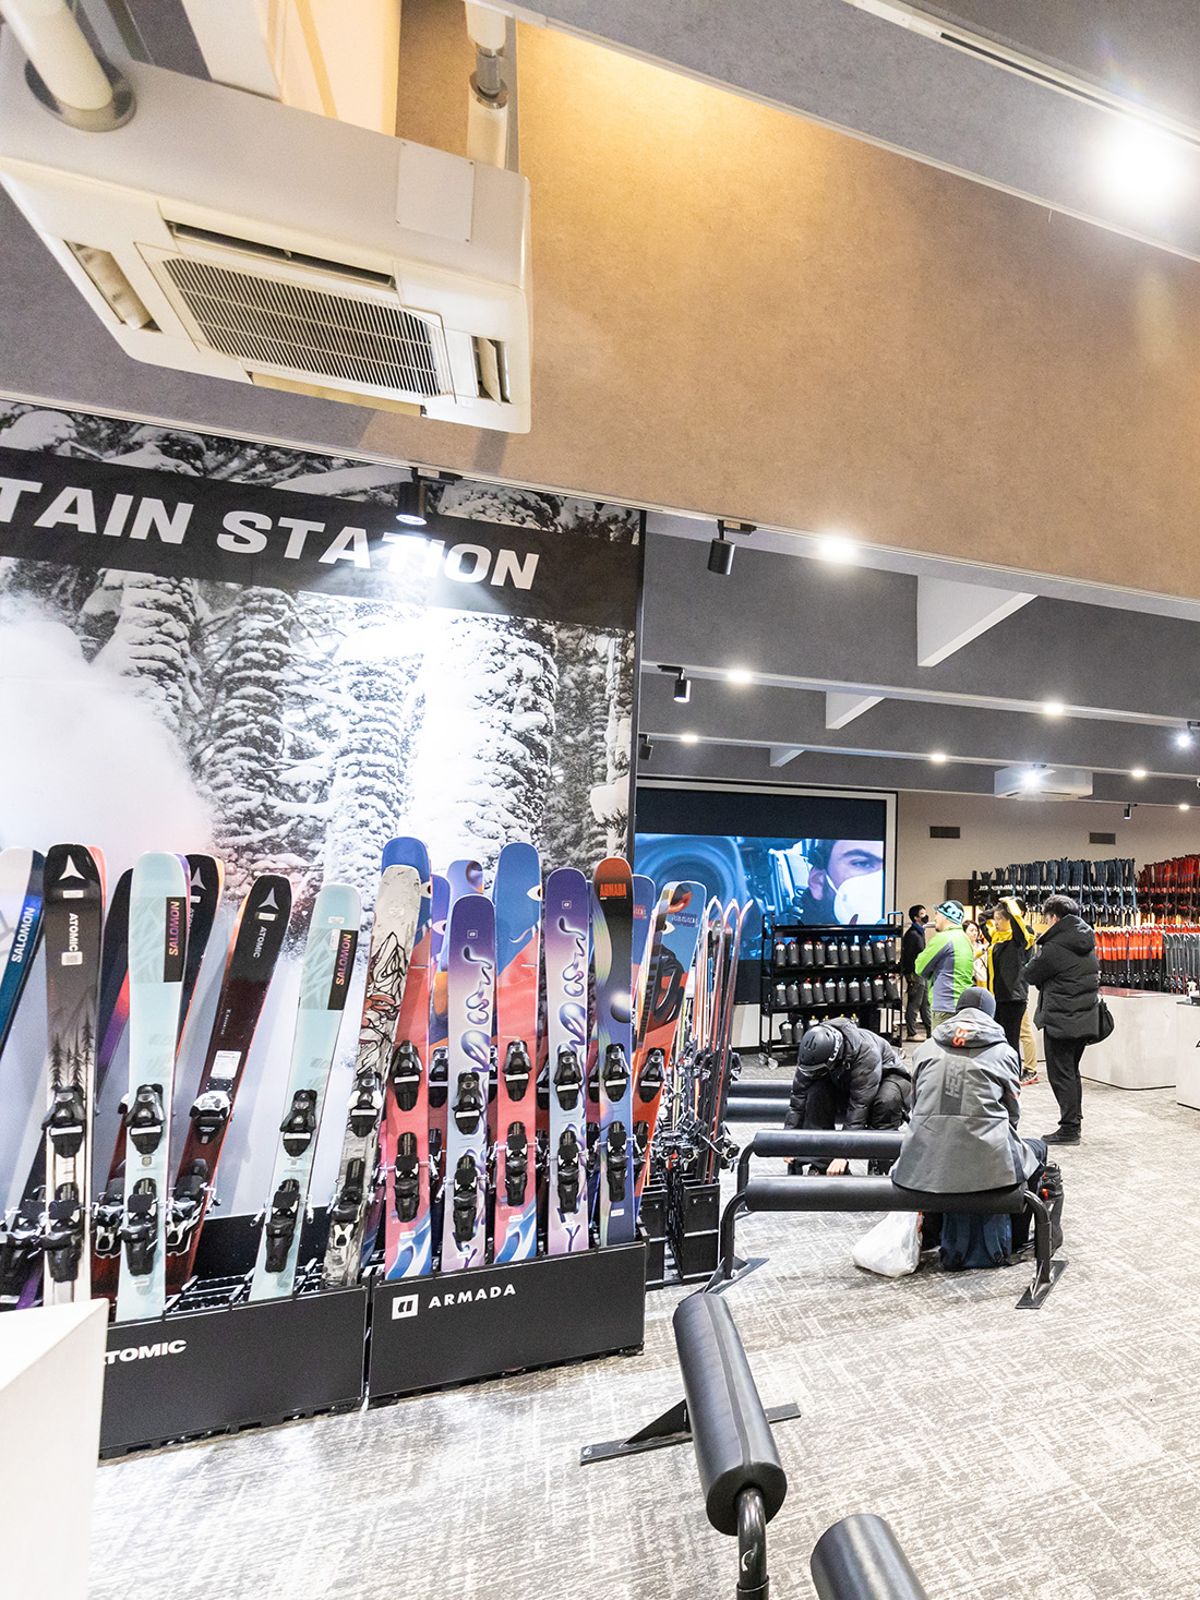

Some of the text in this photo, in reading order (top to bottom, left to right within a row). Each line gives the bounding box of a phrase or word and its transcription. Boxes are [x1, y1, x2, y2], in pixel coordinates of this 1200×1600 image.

[0, 477, 540, 590] TAIN STATION
[12, 907, 36, 963] SALOMON
[69, 913, 79, 952] ATOMIC
[169, 901, 180, 956] SALOMON
[253, 926, 268, 959] ATOMIC
[336, 933, 352, 986] SALOMON
[428, 1284, 517, 1309] ARMADA
[104, 1339, 187, 1366] TOMIC
